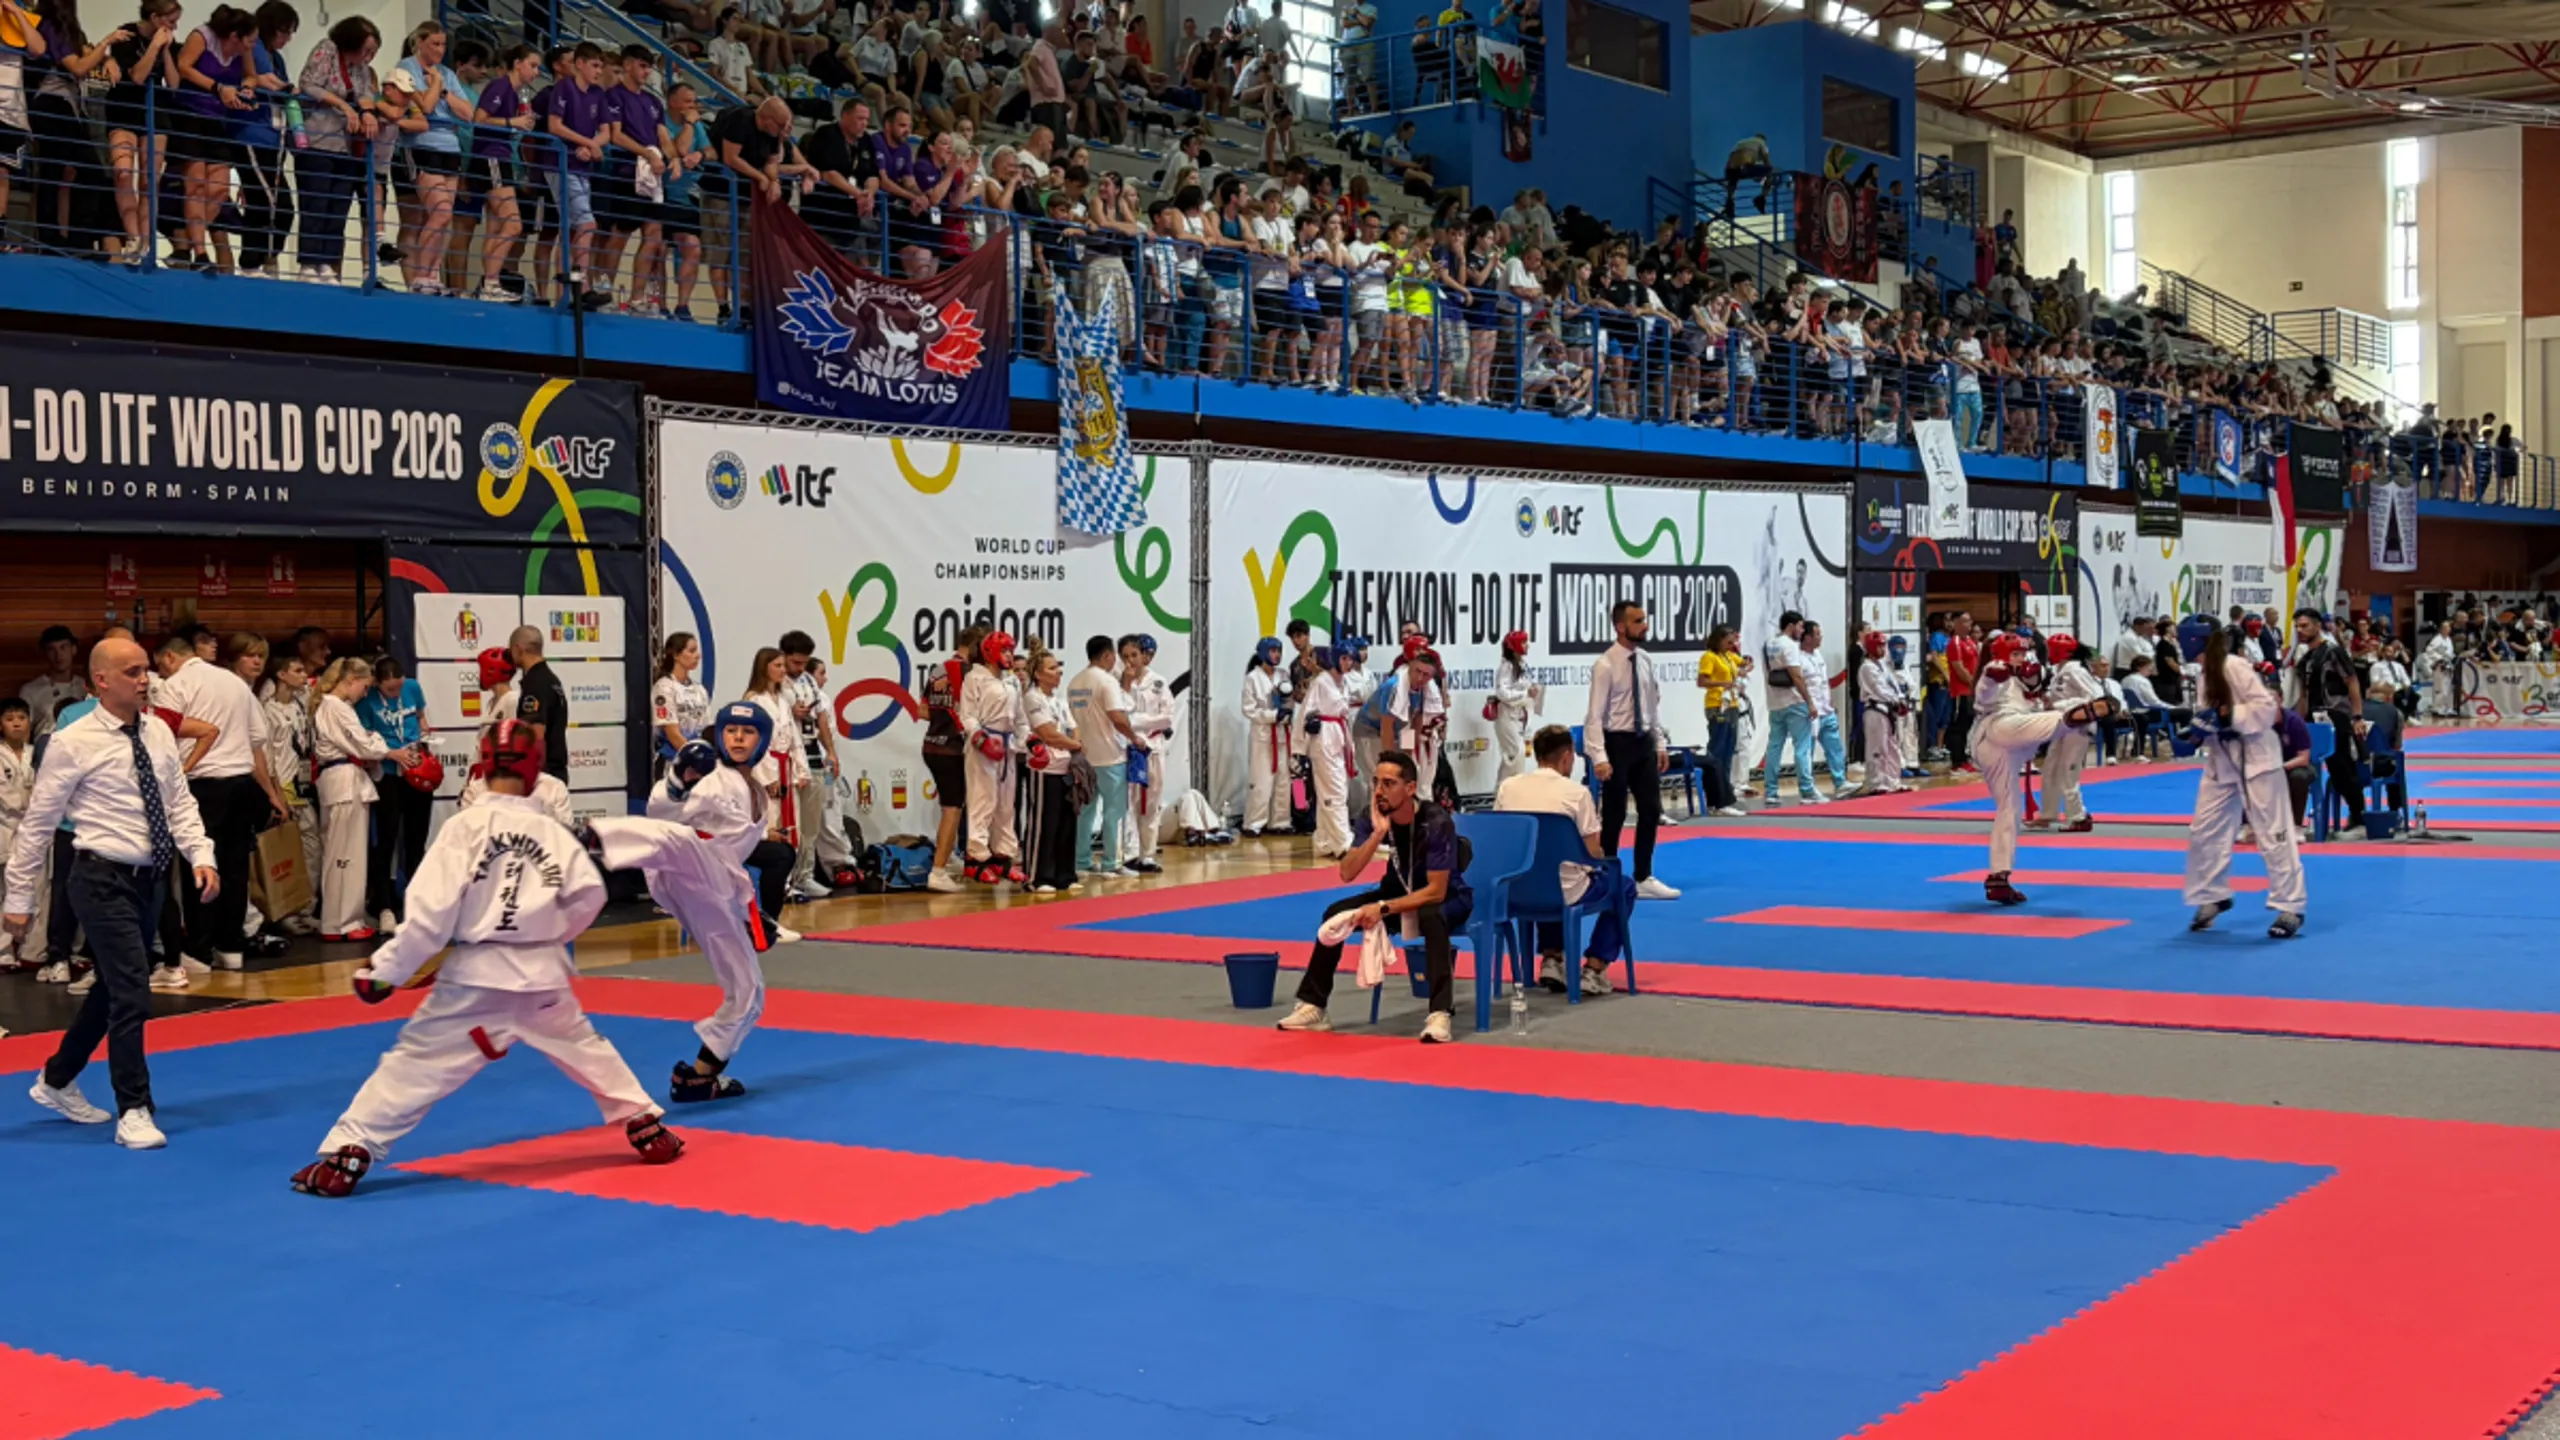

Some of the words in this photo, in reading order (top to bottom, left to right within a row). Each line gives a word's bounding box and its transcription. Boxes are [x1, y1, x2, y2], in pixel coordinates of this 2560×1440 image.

[813, 356, 881, 397] TEAM
[885, 379, 959, 405] LOTUS
[100, 392, 157, 466] ITF
[169, 396, 304, 472] WORLD
[315, 405, 382, 475] CUP
[391, 410, 463, 480] 2026
[22, 478, 182, 498] BENIDORM
[207, 484, 290, 502] SPAIN
[975, 537, 1031, 554] WORLD
[1036, 539, 1066, 555] CUP
[935, 563, 1066, 581] CHAMPIONSHIPS
[1329, 571, 1501, 646] TAEKWON-DO
[1509, 573, 1543, 642] ITF
[1642, 574, 1682, 642] CUP
[1685, 574, 1727, 641] 2026
